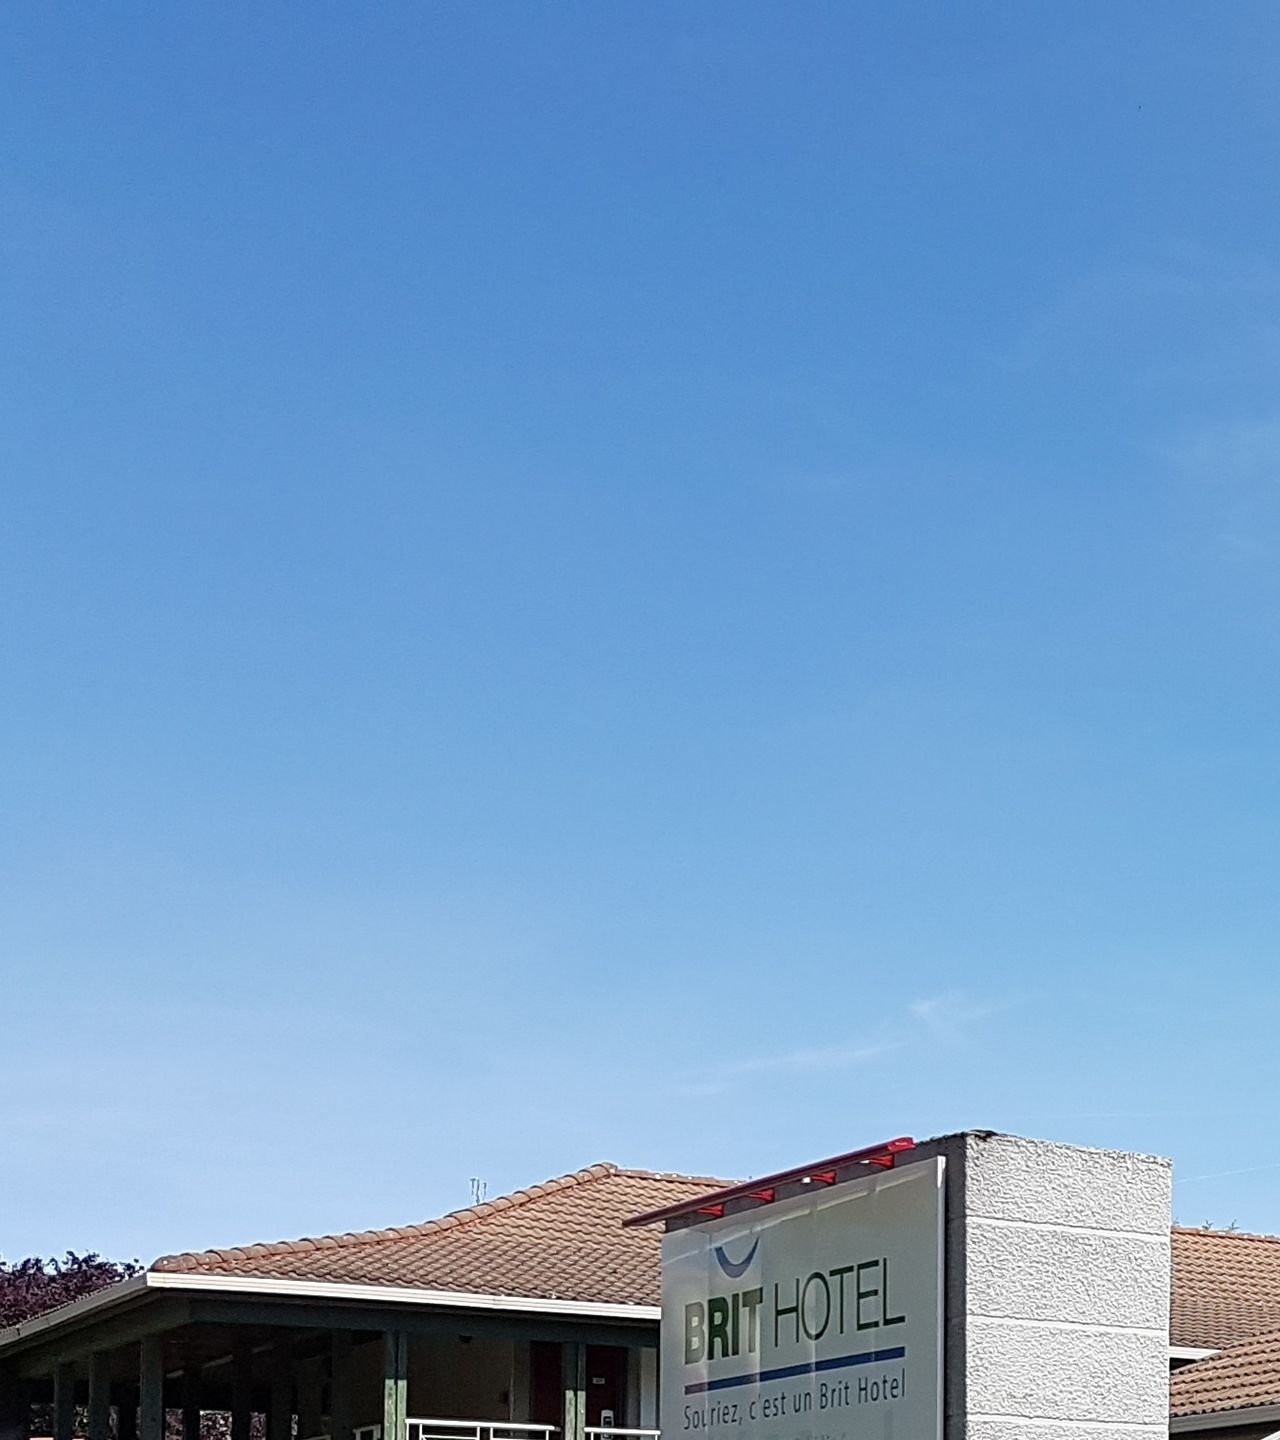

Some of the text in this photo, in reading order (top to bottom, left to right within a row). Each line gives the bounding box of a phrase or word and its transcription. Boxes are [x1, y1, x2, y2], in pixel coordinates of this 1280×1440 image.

[684, 1257, 906, 1365] BRIT HOTEL
[683, 1367, 906, 1430] Souriez, c'est un Brit Hotel
